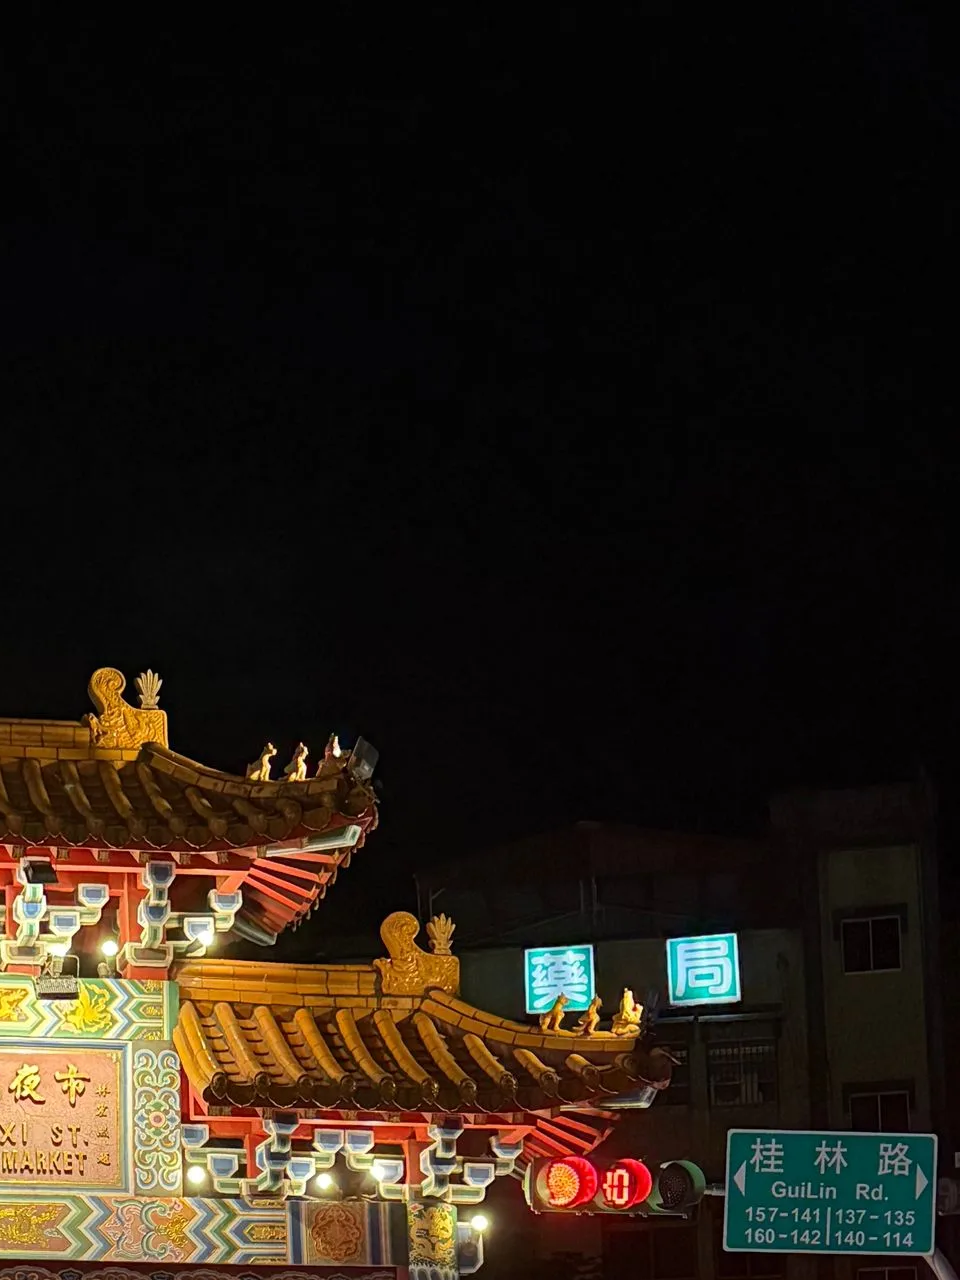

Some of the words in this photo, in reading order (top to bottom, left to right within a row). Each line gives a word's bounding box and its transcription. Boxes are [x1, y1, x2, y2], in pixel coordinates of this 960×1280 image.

[50, 1123, 89, 1148] ST.
[2, 1151, 87, 1176] MARKET
[750, 1138, 913, 1176] 桂林路
[771, 1180, 837, 1200] GuiLin
[856, 1183, 889, 1201] Rd.
[745, 1207, 821, 1223] 157-141
[835, 1209, 916, 1227] 137-135
[744, 1228, 821, 1245] 160-142
[835, 1231, 914, 1247] 140-114
